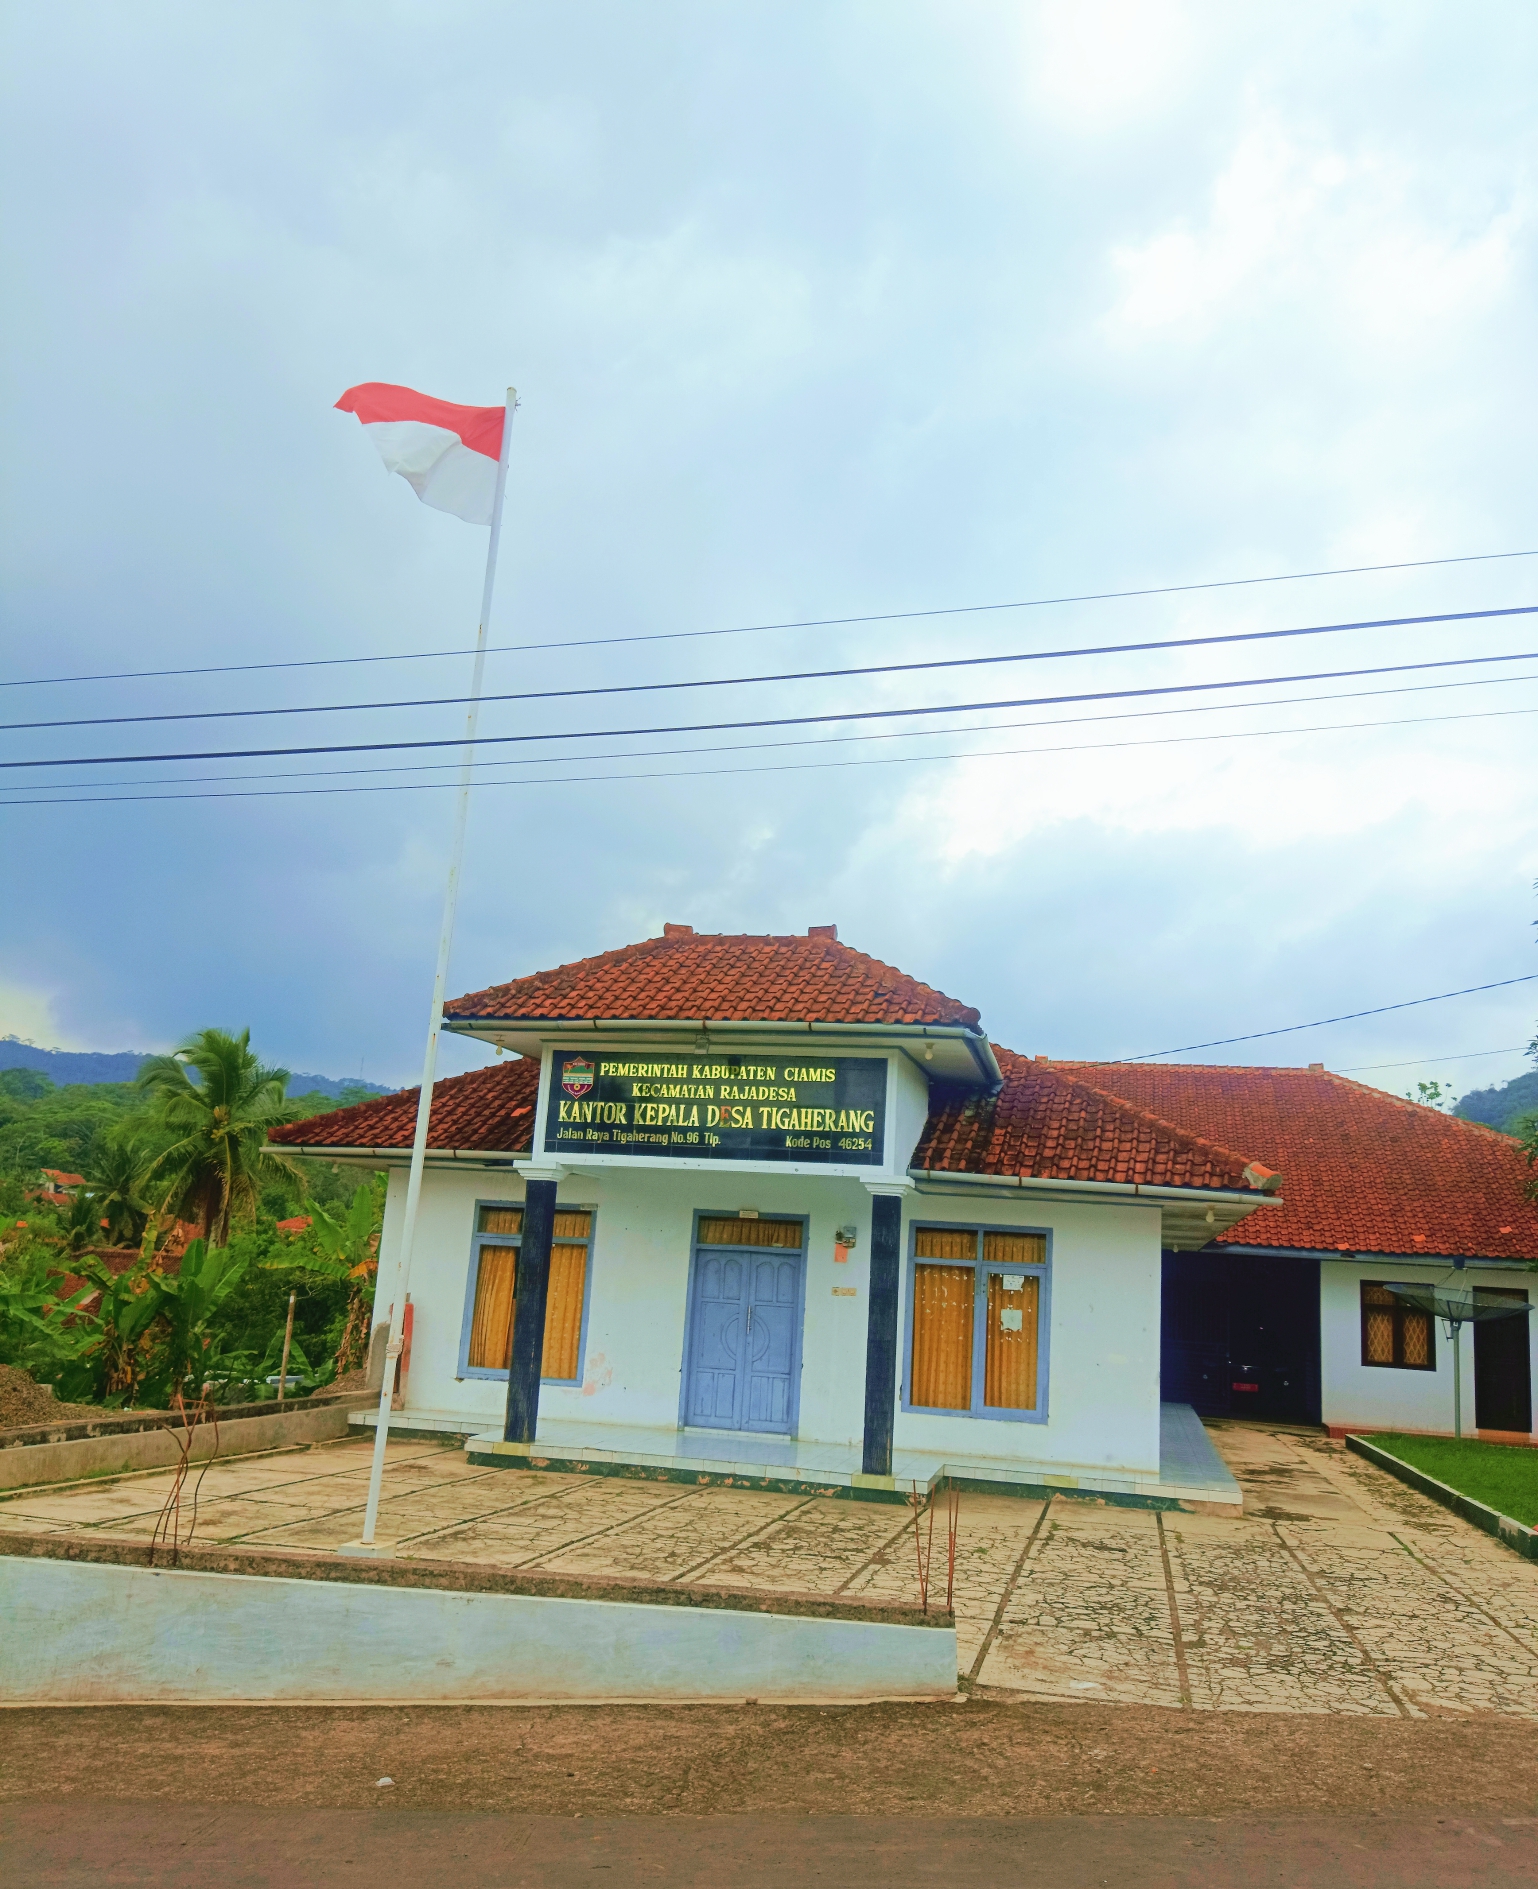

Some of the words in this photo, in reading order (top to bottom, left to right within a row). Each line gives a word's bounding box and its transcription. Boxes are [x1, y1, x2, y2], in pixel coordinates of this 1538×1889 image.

[600, 1063, 687, 1078] PEMERINTAH
[692, 1065, 776, 1081] KABUPATEN
[784, 1067, 836, 1082] CIAMIS
[632, 1083, 714, 1099] KECAMATAN
[720, 1085, 797, 1102] RAJADESA
[558, 1101, 627, 1125] KANTOR
[633, 1103, 700, 1127] KEPALA
[706, 1105, 754, 1129] DESA
[759, 1107, 875, 1133] TIGAHERANG
[557, 1127, 583, 1140] Jalan
[586, 1129, 610, 1143] Raya
[612, 1130, 669, 1145] Tigaherang
[671, 1132, 699, 1144] No.96
[704, 1132, 721, 1147] Tlp.
[786, 1136, 810, 1148] Kode
[813, 1137, 831, 1149] Pos
[838, 1138, 872, 1150] 46254
